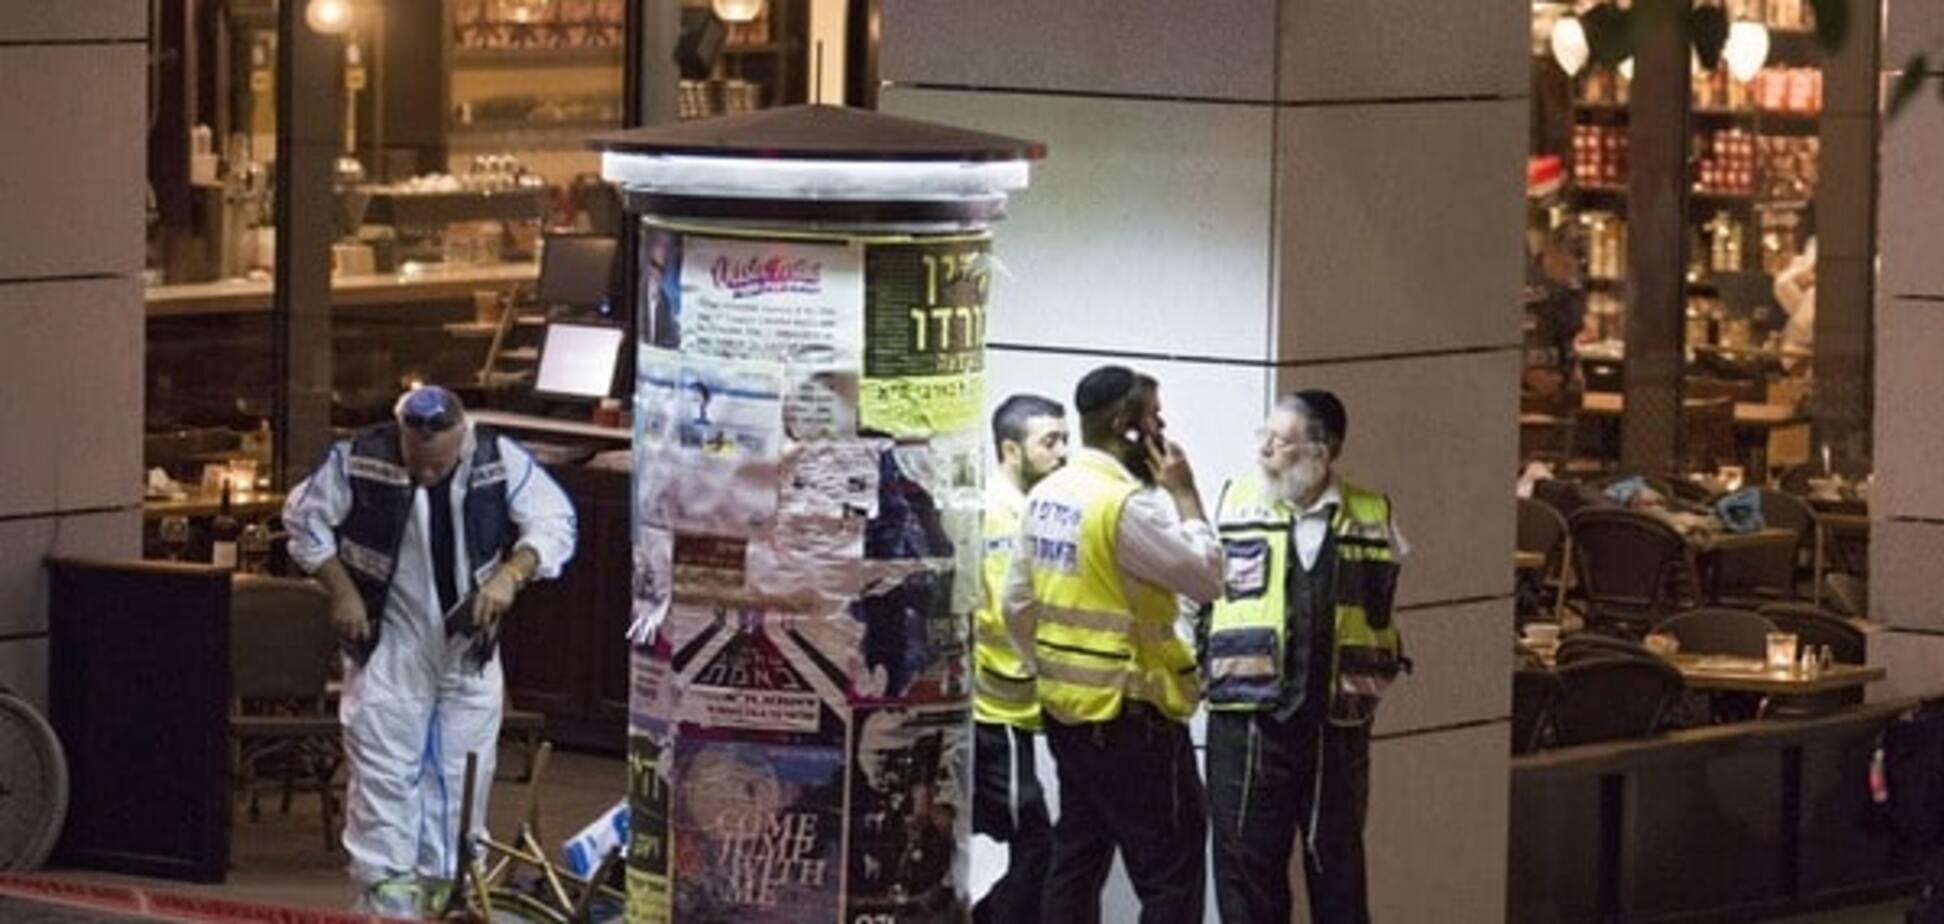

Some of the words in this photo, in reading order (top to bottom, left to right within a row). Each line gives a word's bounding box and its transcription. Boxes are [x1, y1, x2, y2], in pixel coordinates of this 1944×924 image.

[714, 811, 819, 838] COME
[719, 832, 816, 865] JUMP
[732, 857, 827, 886] WITH
